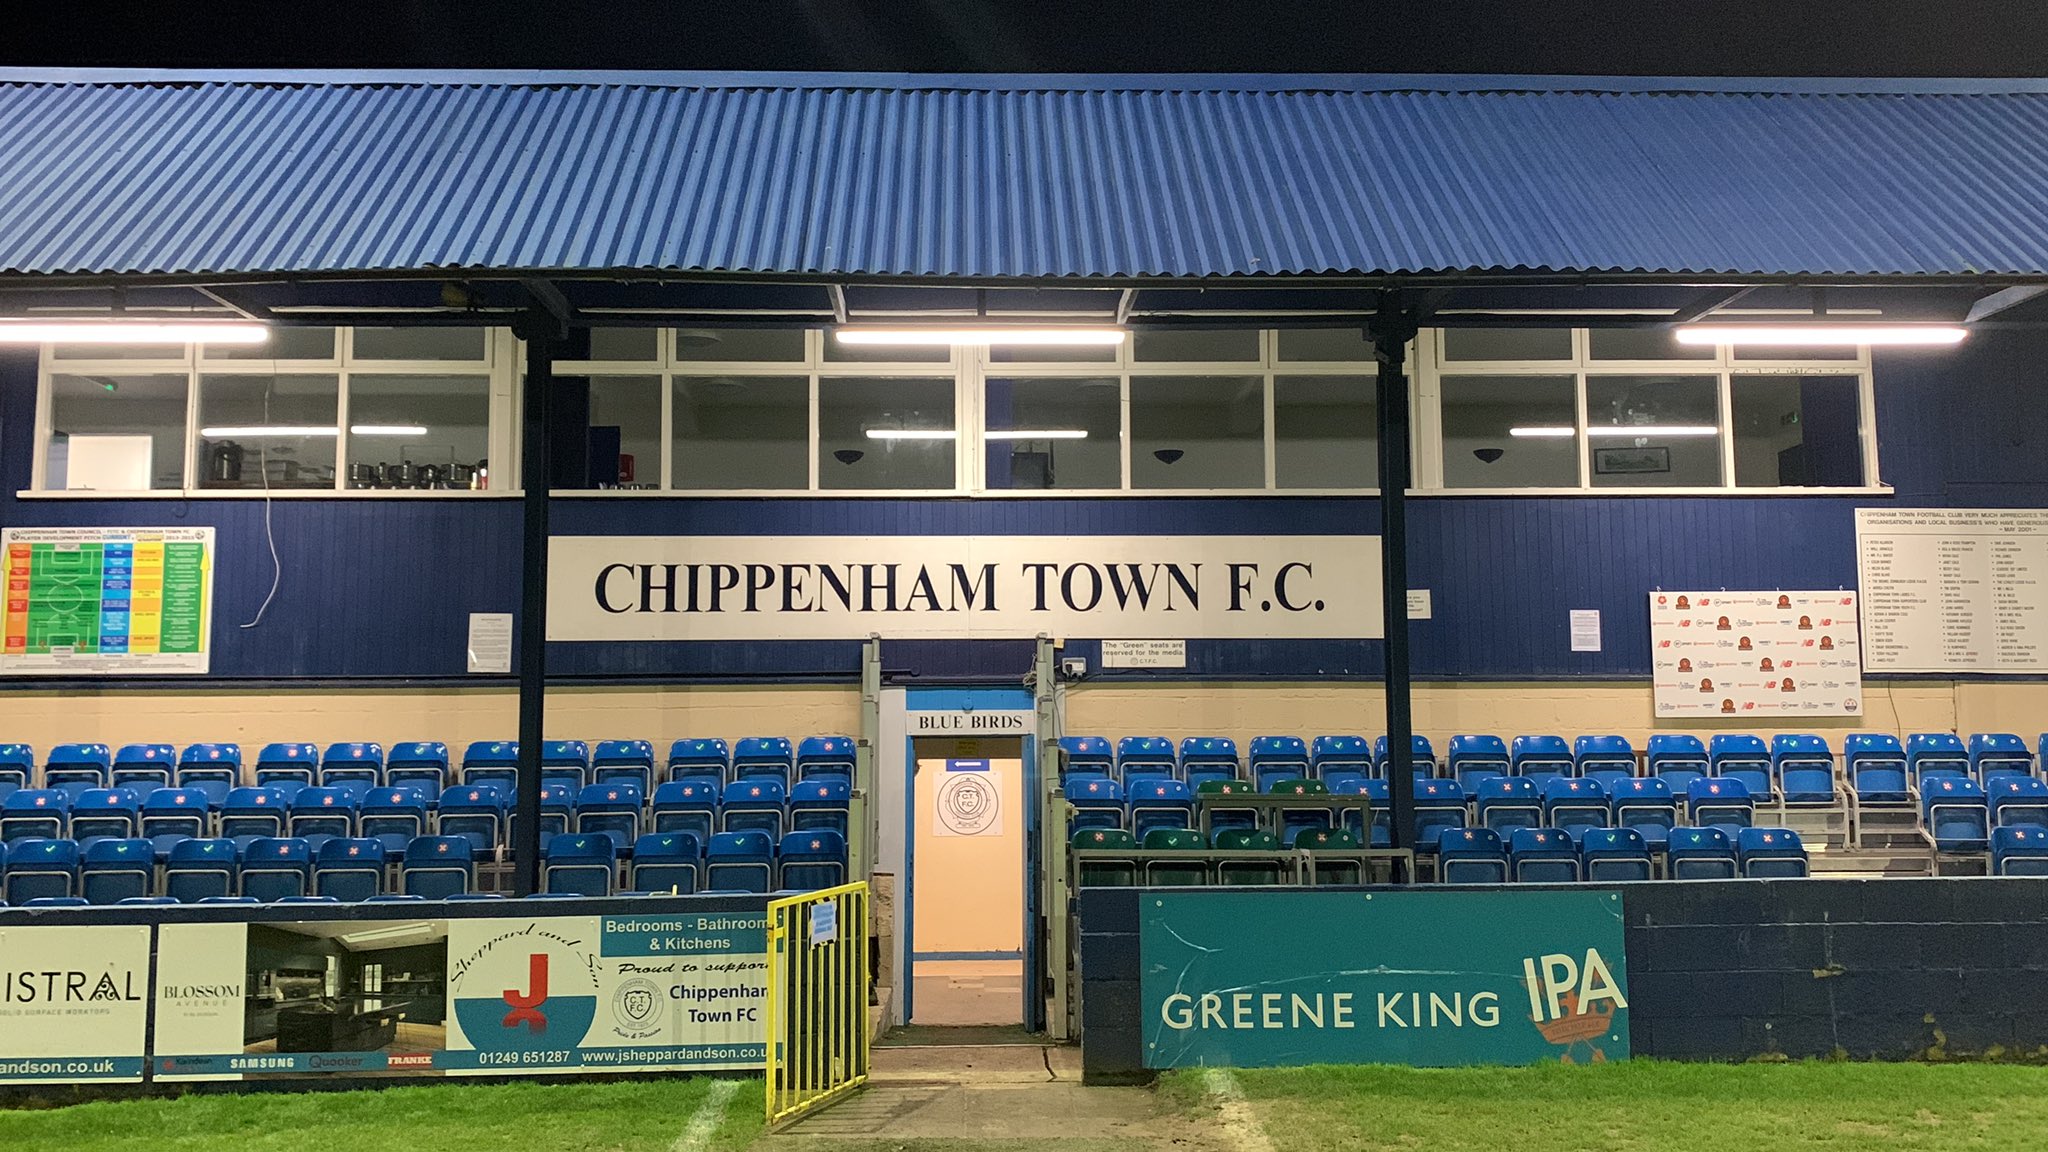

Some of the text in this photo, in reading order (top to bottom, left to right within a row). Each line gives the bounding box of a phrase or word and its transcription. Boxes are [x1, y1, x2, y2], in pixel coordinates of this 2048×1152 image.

[594, 562, 1326, 614] CHIPPENHAM TOWN F.C.
[919, 715, 1023, 729] BLUE BIRDS
[606, 920, 683, 933] Bedrooms
[697, 918, 768, 931] Bathroom
[650, 936, 731, 951] & Kitchens
[451, 923, 603, 993] Sheppard and Son
[618, 961, 768, 974] Proud to suppor
[6, 971, 142, 1002] ISTRAL
[503, 953, 548, 1009] J
[1522, 947, 1628, 1022] IPA
[164, 984, 240, 999] BLOSSOM
[25, 1008, 62, 1016] SURFACE
[688, 1007, 757, 1023] Town FC
[1161, 991, 1500, 1030] GREENE KING
[230, 1057, 294, 1069] SAMSUNG
[308, 1055, 364, 1068] Quooker
[388, 1056, 432, 1066] FRANKE
[479, 1048, 768, 1064] 01249 651287 www.jsheppardandson.co.u
[0, 1059, 114, 1074] andson.co.uk
